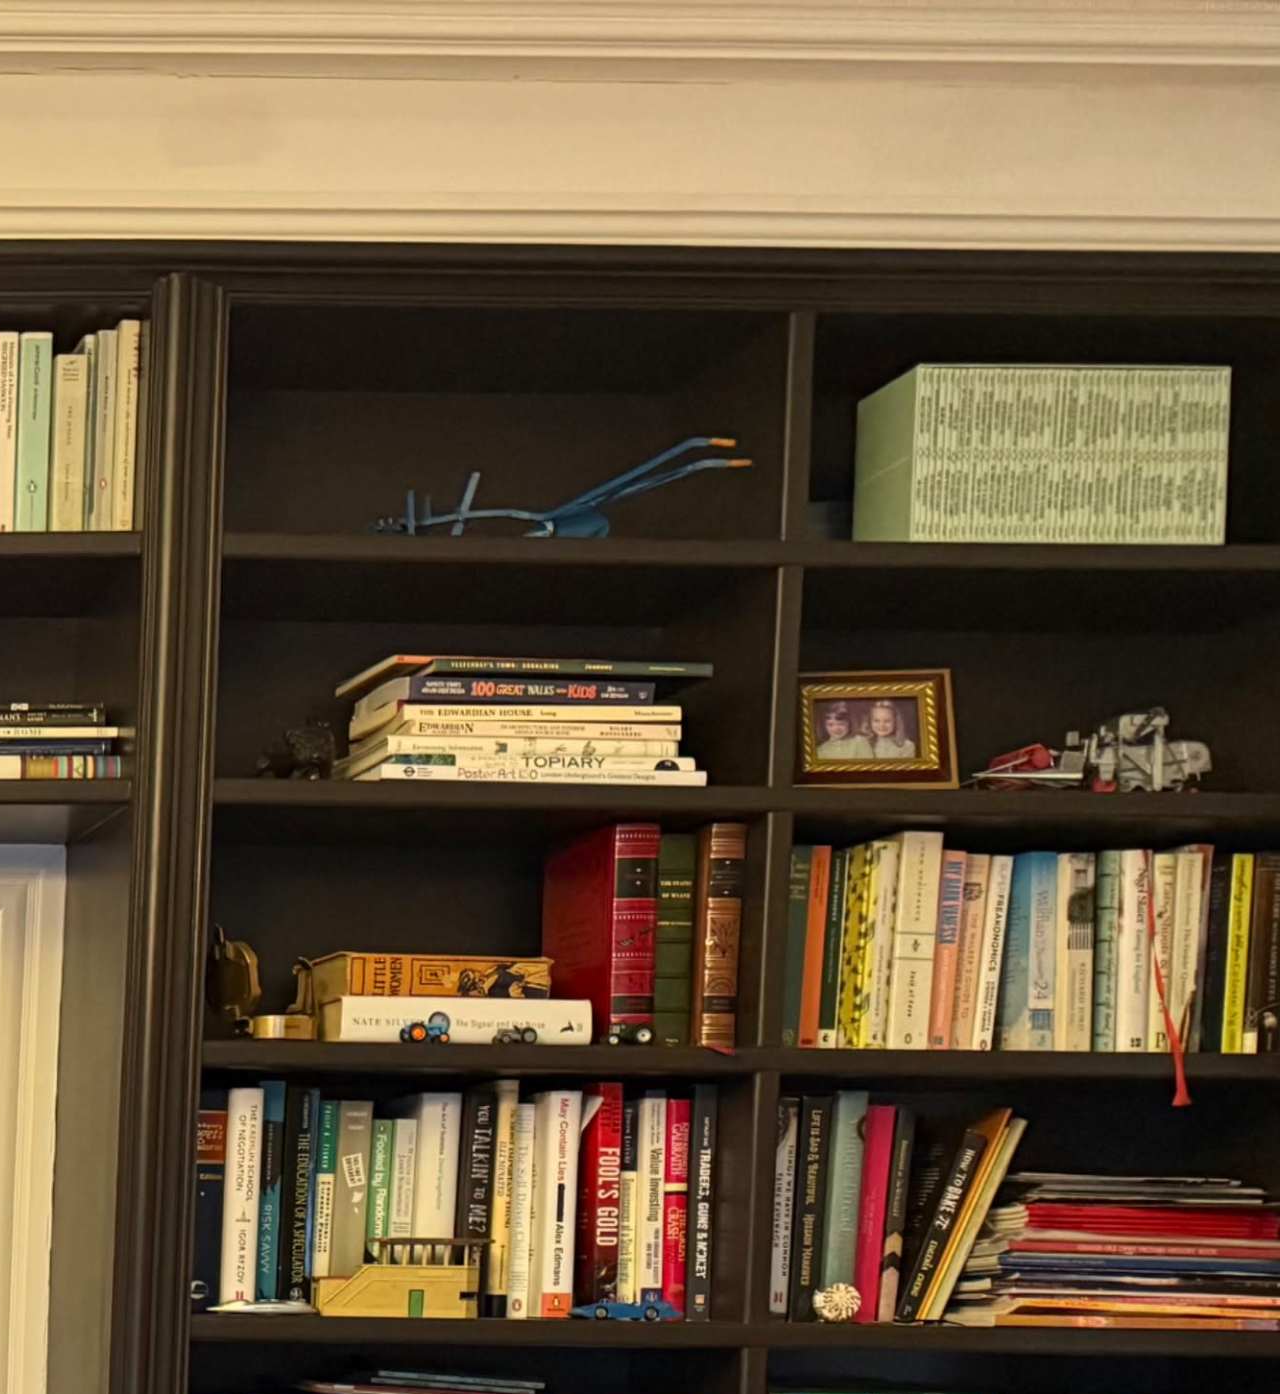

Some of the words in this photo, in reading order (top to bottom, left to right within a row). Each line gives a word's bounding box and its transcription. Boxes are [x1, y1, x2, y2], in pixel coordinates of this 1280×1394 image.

[470, 682, 495, 697] 100
[567, 685, 597, 699] KIDS
[438, 708, 496, 718] EDWARDIAN
[498, 708, 533, 718] HOUSE
[520, 755, 606, 769] TOPIARY
[372, 955, 387, 997] LITTLE
[390, 957, 402, 997] WOMEN
[558, 1098, 570, 1119] May
[298, 1133, 310, 1152] THE
[557, 1121, 569, 1159] Contain
[235, 1129, 247, 1192] NEGOTIATION
[471, 1127, 492, 1184] TALKIN'
[649, 1148, 663, 1175] Value
[295, 1154, 310, 1205] EDUCATION
[557, 1161, 566, 1181] Lies
[597, 1147, 620, 1199] FOOL'S
[647, 1178, 661, 1222] Investing
[941, 1185, 962, 1213] BAKE
[263, 1204, 273, 1231] RISK
[295, 1207, 306, 1220] OF
[469, 1204, 487, 1232] ME?
[596, 1206, 619, 1246] GOLD
[238, 1228, 247, 1251] IGOR
[555, 1224, 564, 1244] Alex
[261, 1235, 272, 1274] SAVVY
[292, 1228, 305, 1284] SPECULATOR
[552, 1247, 563, 1286] Edmans
